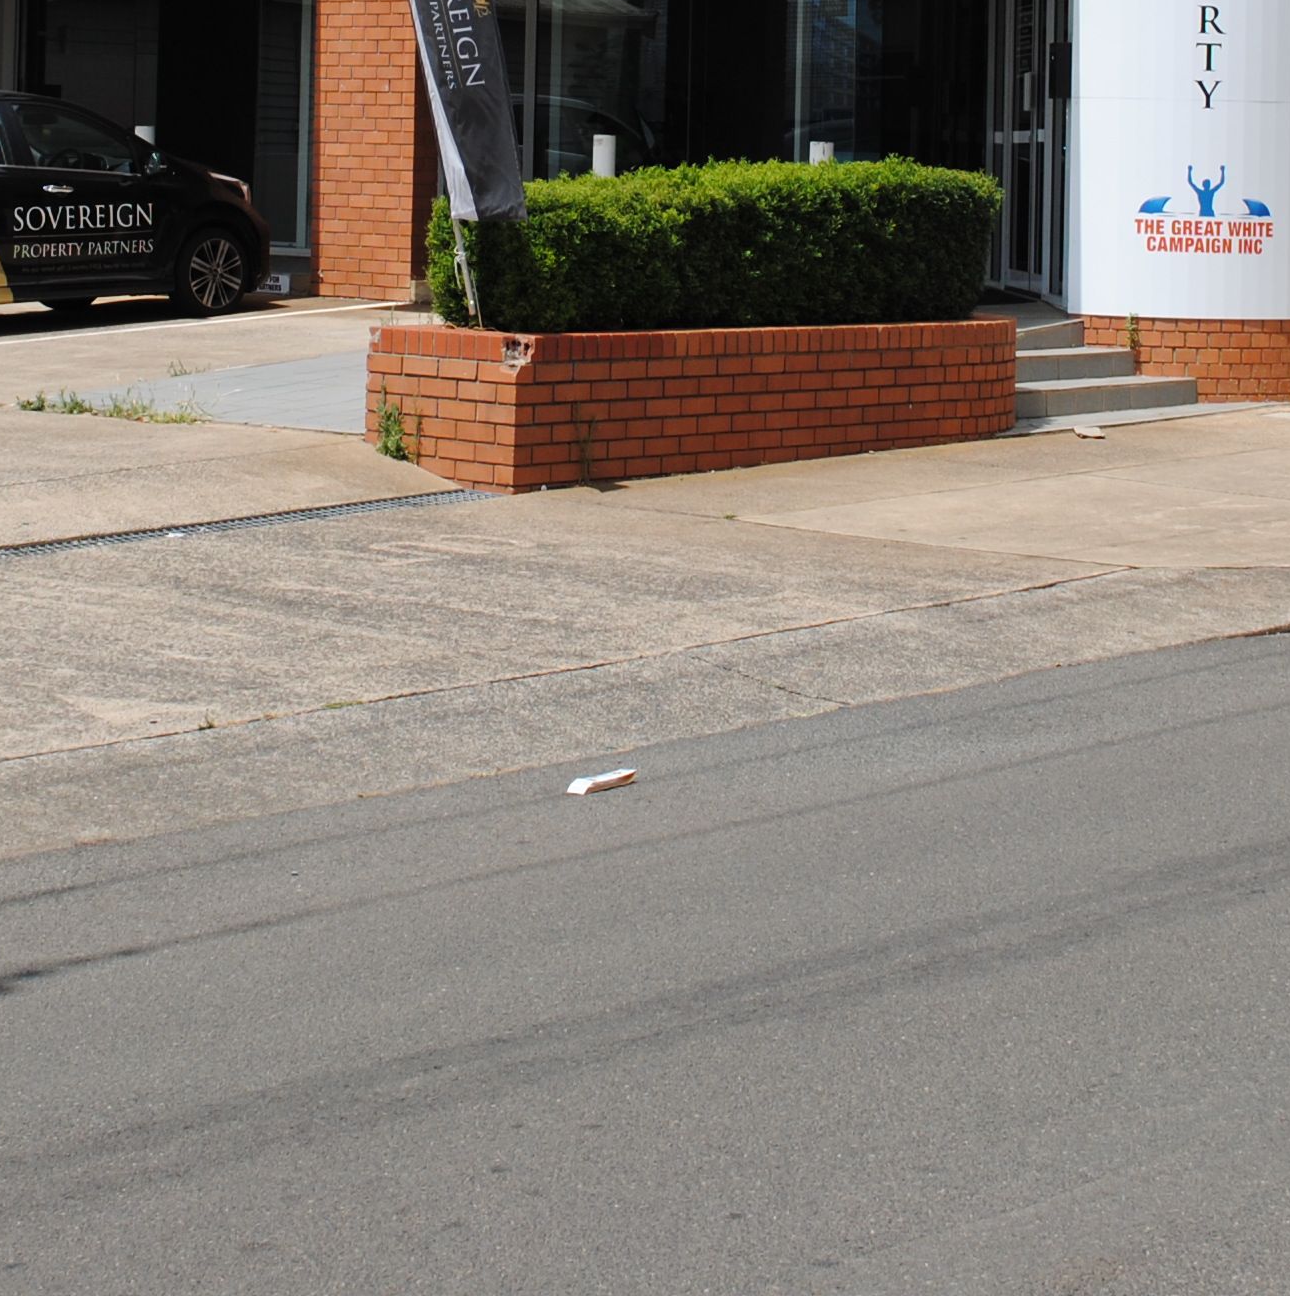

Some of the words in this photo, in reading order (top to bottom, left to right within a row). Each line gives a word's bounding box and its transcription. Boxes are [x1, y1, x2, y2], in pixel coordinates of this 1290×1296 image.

[428, 0, 457, 91] PARTNERS
[13, 202, 154, 233] SOVEREIGN
[1134, 218, 1165, 235] THE
[1171, 219, 1225, 237] GREAT
[1227, 221, 1274, 238] WHITE
[13, 241, 85, 259] PROPERTY
[87, 236, 154, 257] PARTNERS
[1146, 235, 1236, 255] CAMPAIGN
[1239, 237, 1263, 255] INC
